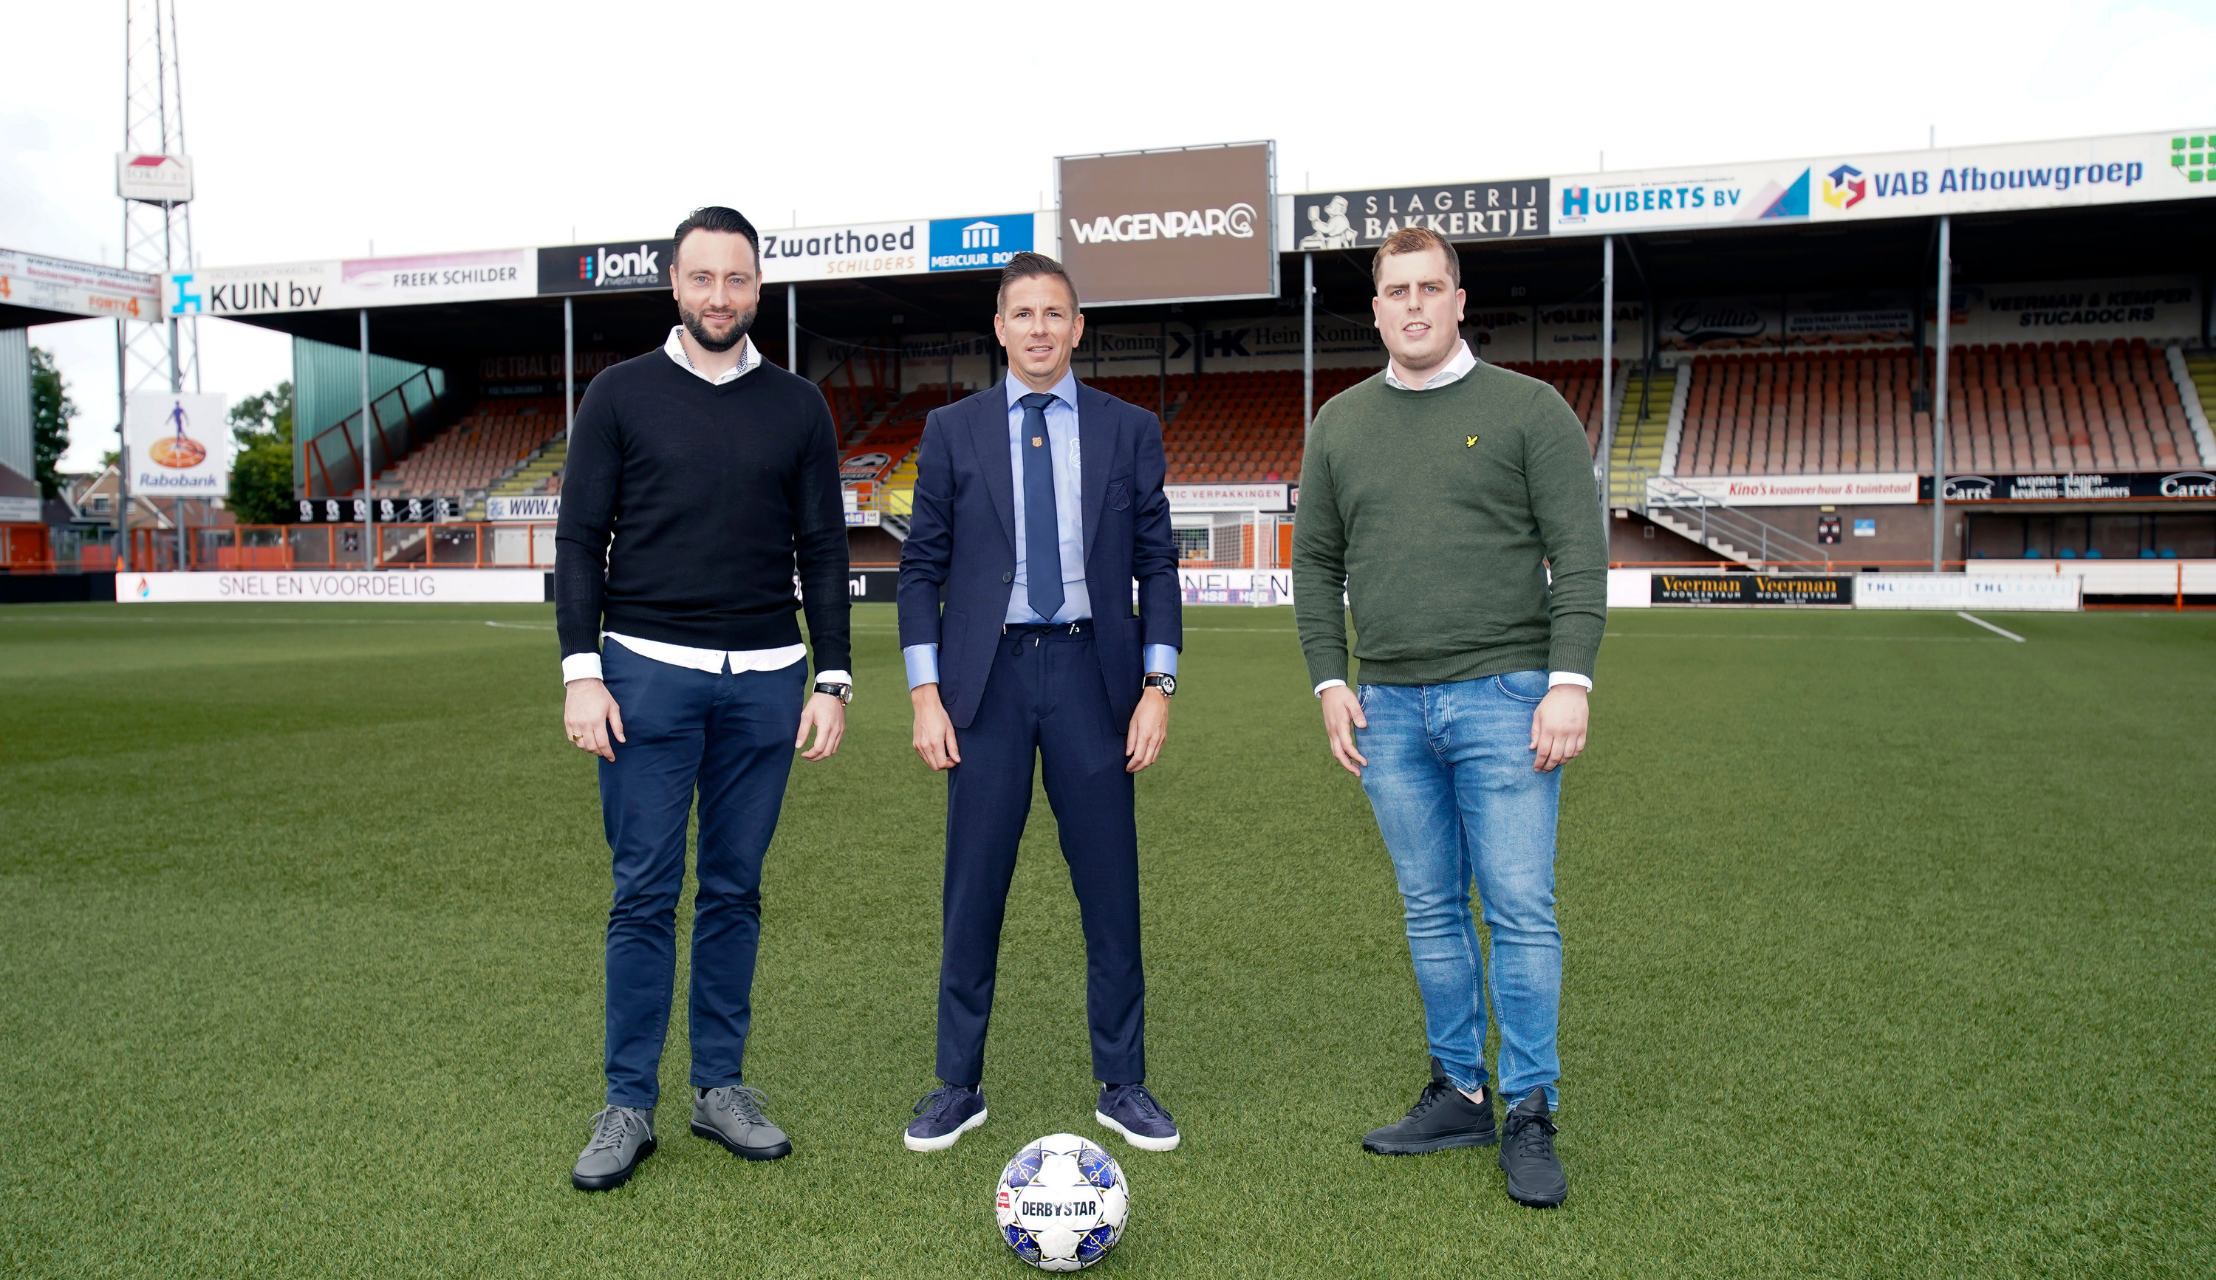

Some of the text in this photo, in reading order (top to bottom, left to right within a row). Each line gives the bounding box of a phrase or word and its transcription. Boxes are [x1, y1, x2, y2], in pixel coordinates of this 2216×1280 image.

[1874, 160, 2144, 198] VAB Afbouwgroep
[1364, 186, 1537, 215] SLAGERIJ
[1713, 188, 1741, 207] BV
[1364, 208, 1538, 238] BAKKERTJE
[763, 225, 914, 258] Zwarthoed
[595, 244, 659, 287] jonk
[826, 256, 915, 274] SCHILDERS
[931, 253, 988, 268] MERCUUR
[393, 267, 517, 288] FREEK SCHILDER
[604, 274, 659, 286] investments
[211, 281, 322, 311] KUIN bv
[1990, 293, 2086, 311] VEERMAN
[2107, 287, 2192, 307] KEMPER
[1539, 306, 1645, 324] VOLENAM
[1255, 326, 1300, 344] Hein
[1313, 322, 1382, 345] Koning
[1101, 332, 1162, 354] Koning
[139, 473, 218, 488] Rabobank
[1729, 482, 1767, 496] Kino's
[1769, 483, 1842, 495] kraanverhuur
[1845, 483, 1853, 494] &
[1855, 482, 1912, 494] tuintotaal
[1163, 490, 1188, 500] STIC
[1192, 489, 1281, 500] VERPAKKINGEN
[1942, 482, 1992, 500] Carré
[219, 576, 436, 596] SNEL EN VOORDELIG
[1662, 576, 1741, 593] Veerman
[1755, 576, 1838, 593] Veerman
[1662, 590, 1741, 599] WOONCENTRUM
[1756, 591, 1838, 600] WOONCENTRUM
[1022, 1201, 1097, 1217] DERBYSTAR
